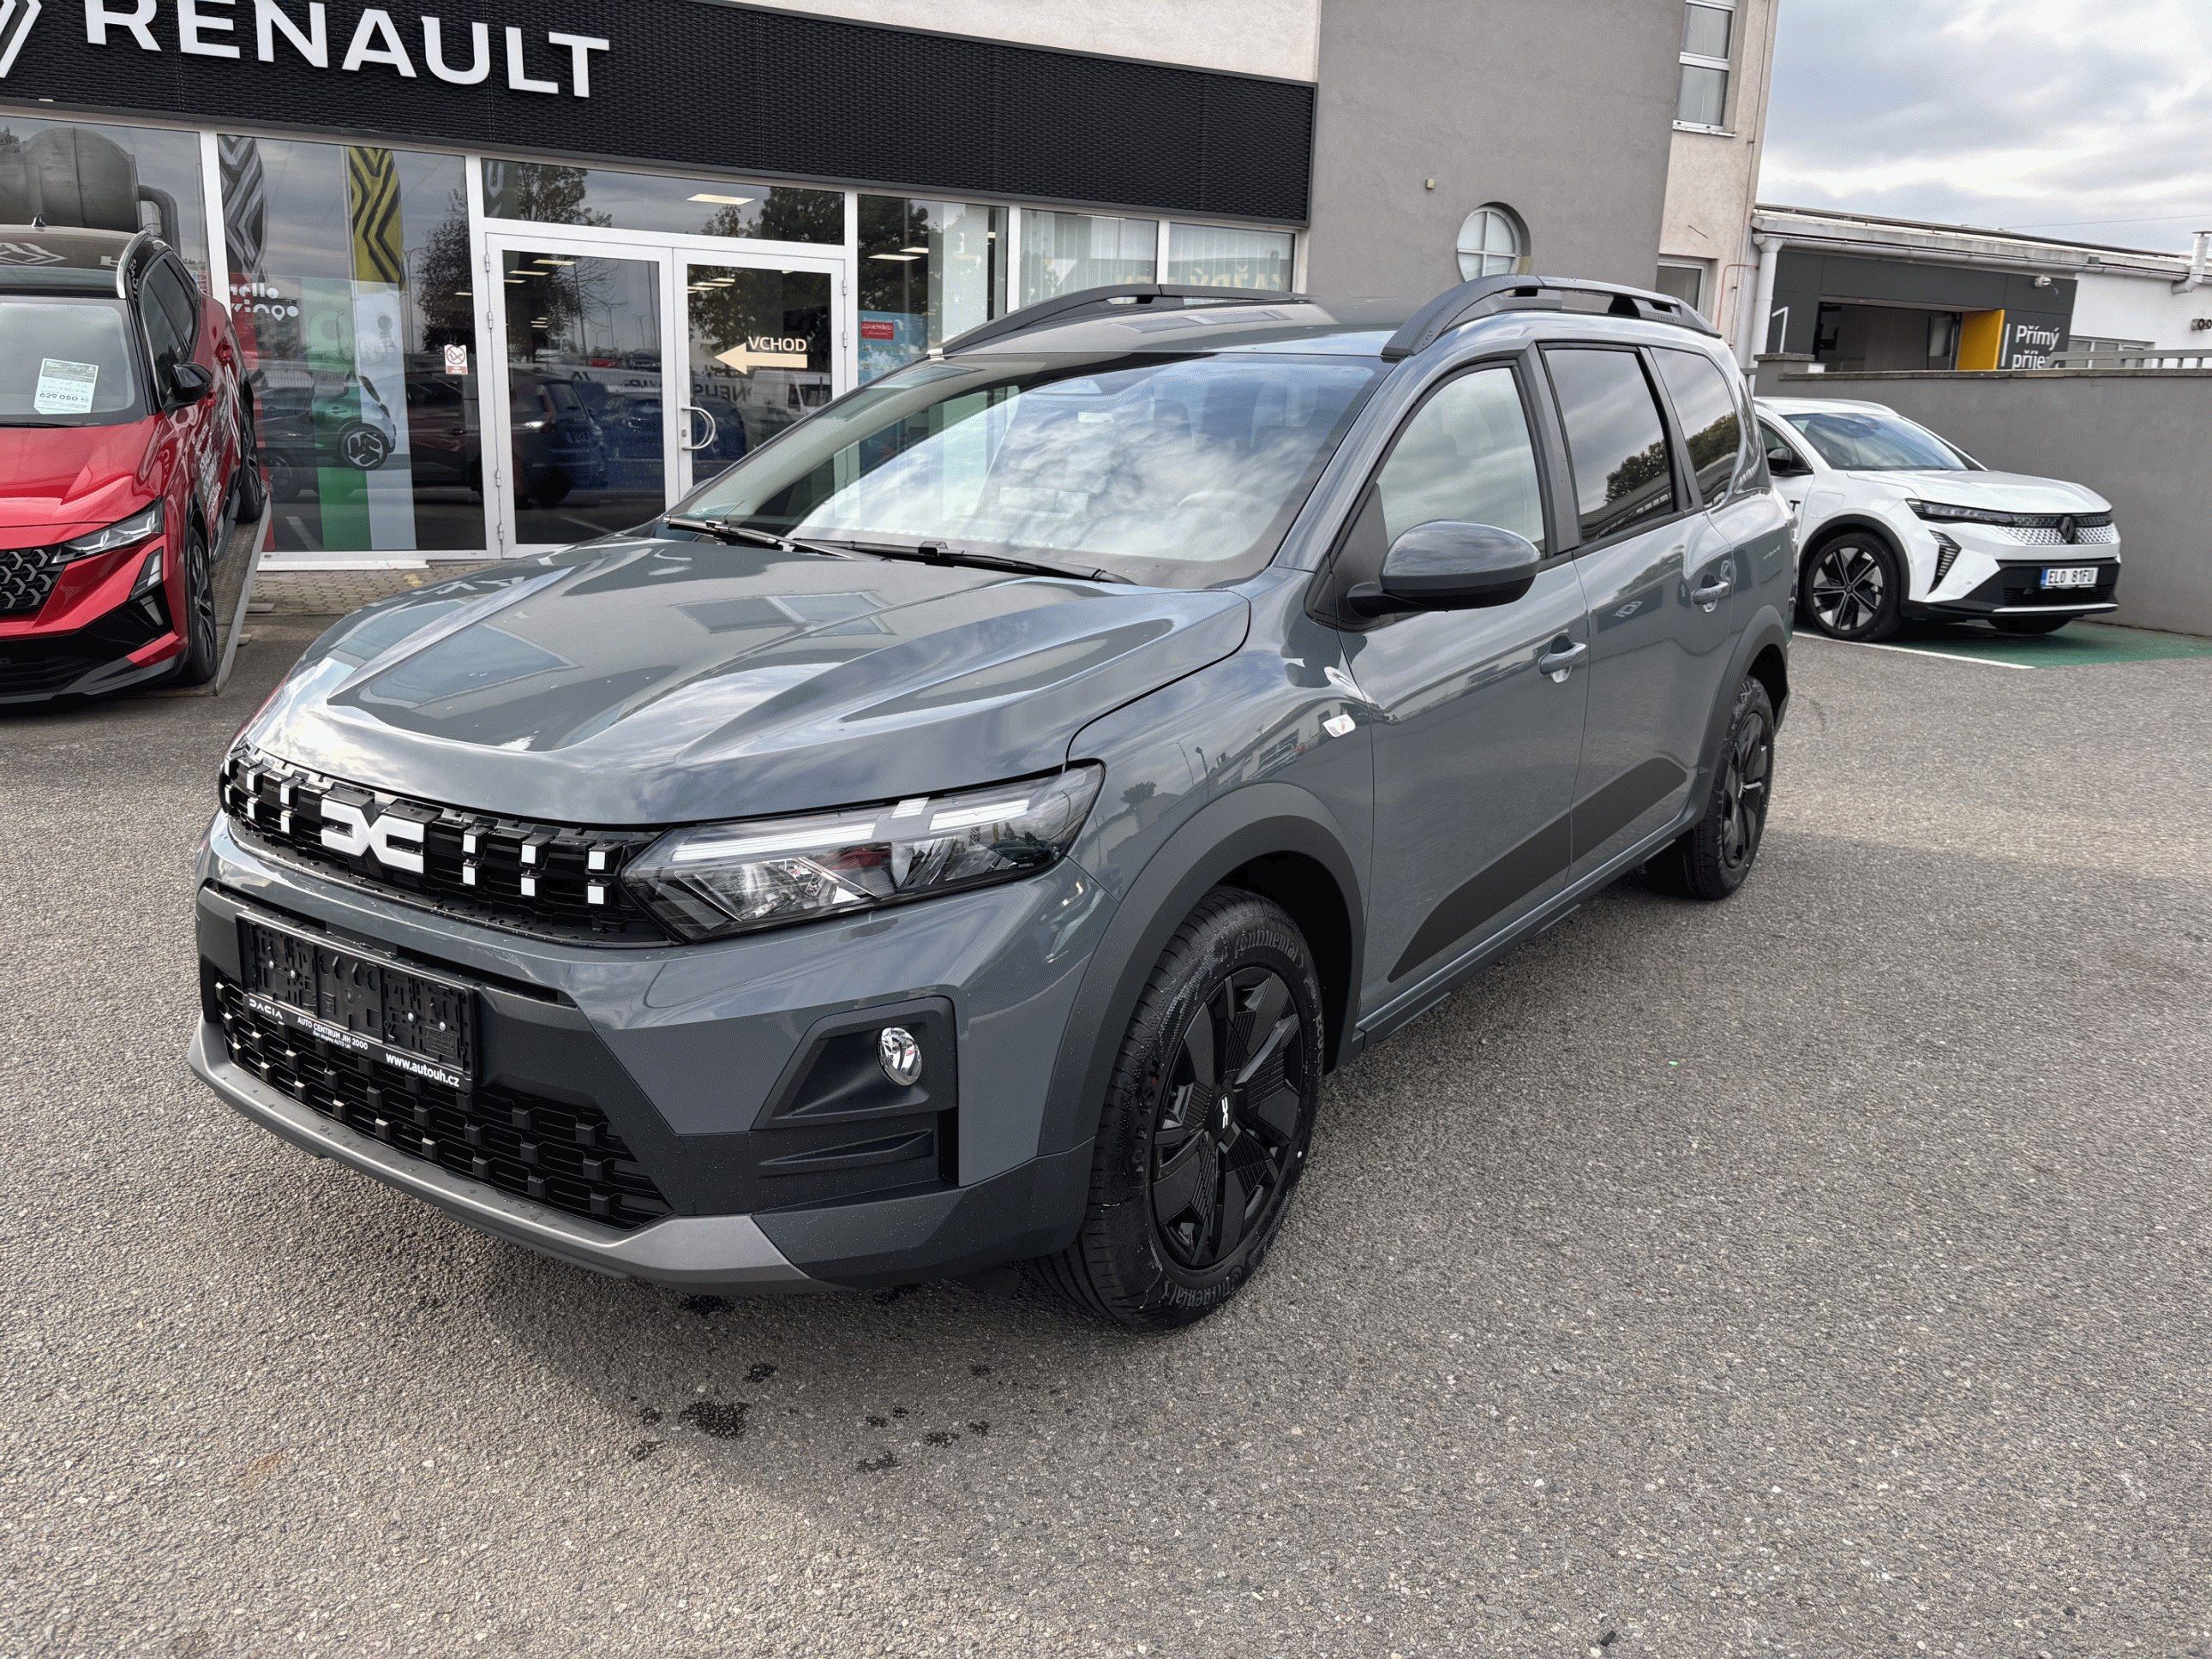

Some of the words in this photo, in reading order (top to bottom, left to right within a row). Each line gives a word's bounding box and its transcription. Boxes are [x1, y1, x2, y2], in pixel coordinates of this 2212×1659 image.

[84, 0, 610, 98] RENAULT
[747, 335, 807, 352] VCHOD
[2015, 325, 2060, 351] Přímý
[249, 998, 284, 1020] DACIA
[297, 1016, 313, 1028] AUTO
[313, 1023, 341, 1039] CENTRUM
[352, 1038, 369, 1051] 2000
[386, 1052, 460, 1087] www.autouh.cz
